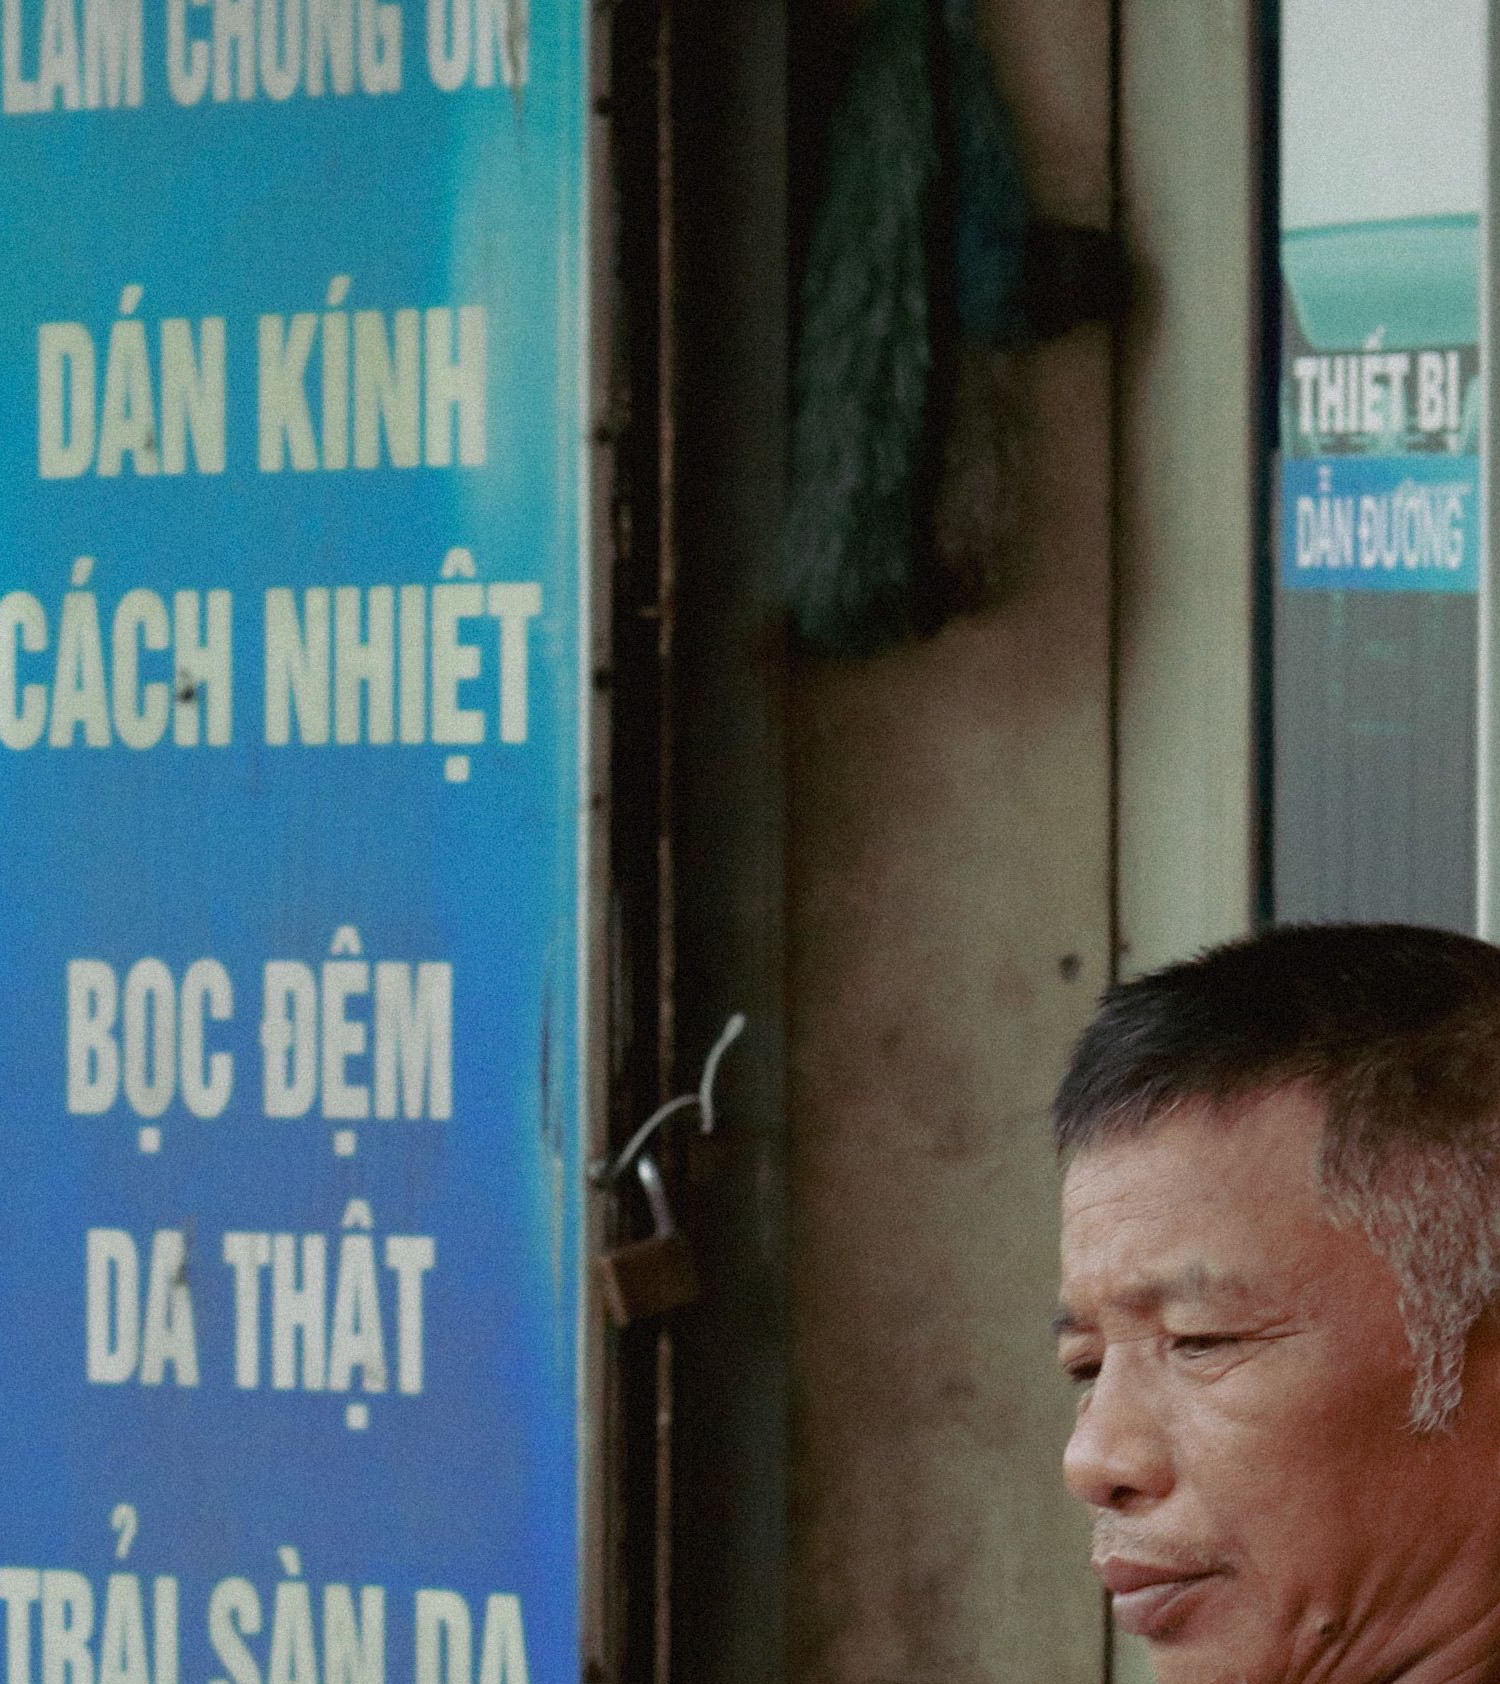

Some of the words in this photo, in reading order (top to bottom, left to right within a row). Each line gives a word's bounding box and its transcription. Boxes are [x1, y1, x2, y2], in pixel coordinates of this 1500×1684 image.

[37, 283, 227, 480] DÁN
[258, 274, 489, 473] KÍNH
[1294, 325, 1410, 437] THIẾT
[1417, 350, 1461, 455] BỊ
[264, 547, 543, 784] NHIỆT
[67, 957, 235, 1154] BỌC
[260, 925, 453, 1158] ĐỆM
[86, 1228, 200, 1388] DA
[223, 1199, 436, 1430] THẬT
